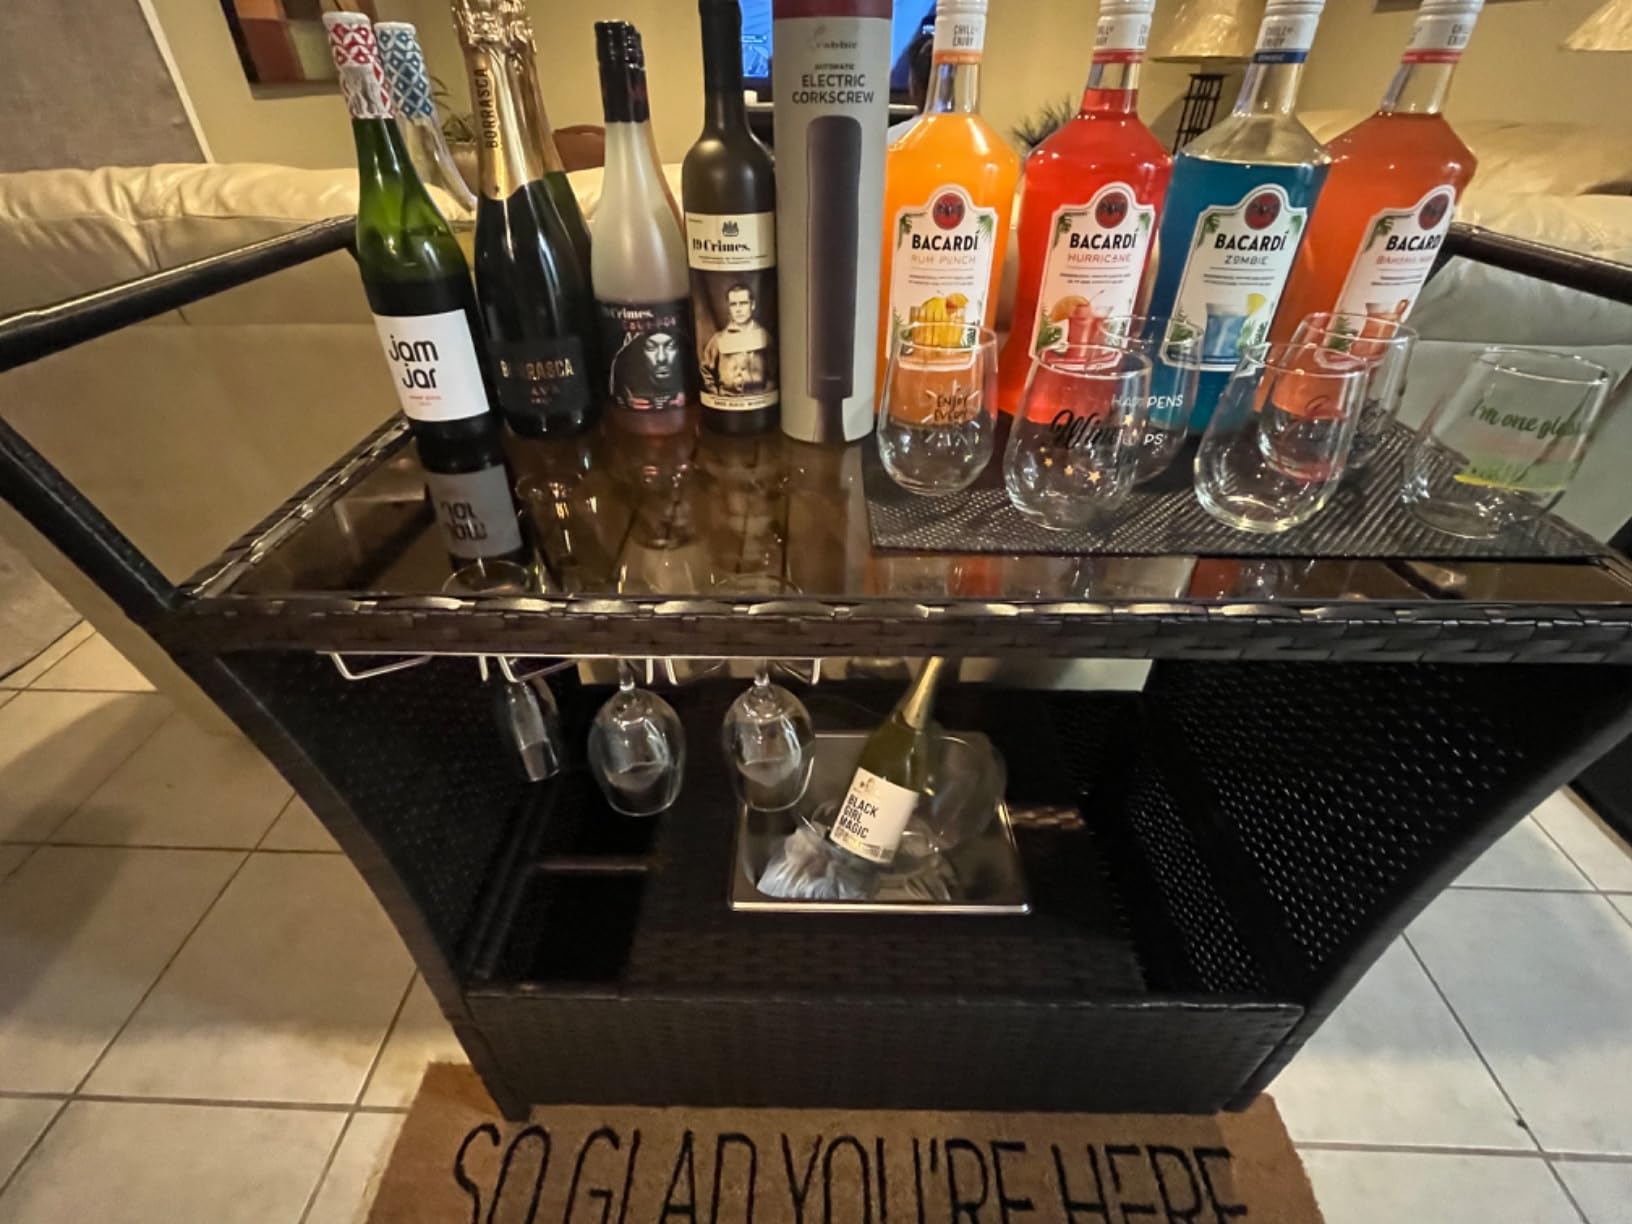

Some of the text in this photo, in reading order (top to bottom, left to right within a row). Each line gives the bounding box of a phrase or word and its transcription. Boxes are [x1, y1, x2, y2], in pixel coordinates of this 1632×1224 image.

[802, 74, 866, 88] ELECTRIC
[792, 91, 875, 104] CORKSCREW
[475, 68, 498, 149] BORRASCA
[911, 255, 976, 265] RUM PUNCH
[1067, 253, 1132, 263] HURRICANE
[1225, 255, 1269, 265] ZOMBIE
[388, 335, 439, 362] jam
[402, 363, 436, 389] jar
[500, 358, 575, 379] BRASCA
[1501, 414, 1539, 432] one
[843, 805, 863, 824] GIRL
[848, 793, 878, 818] BLACK
[839, 815, 869, 838] MAGIC
[453, 1123, 1248, 1224] SO GLAD YOU'RE HERE
